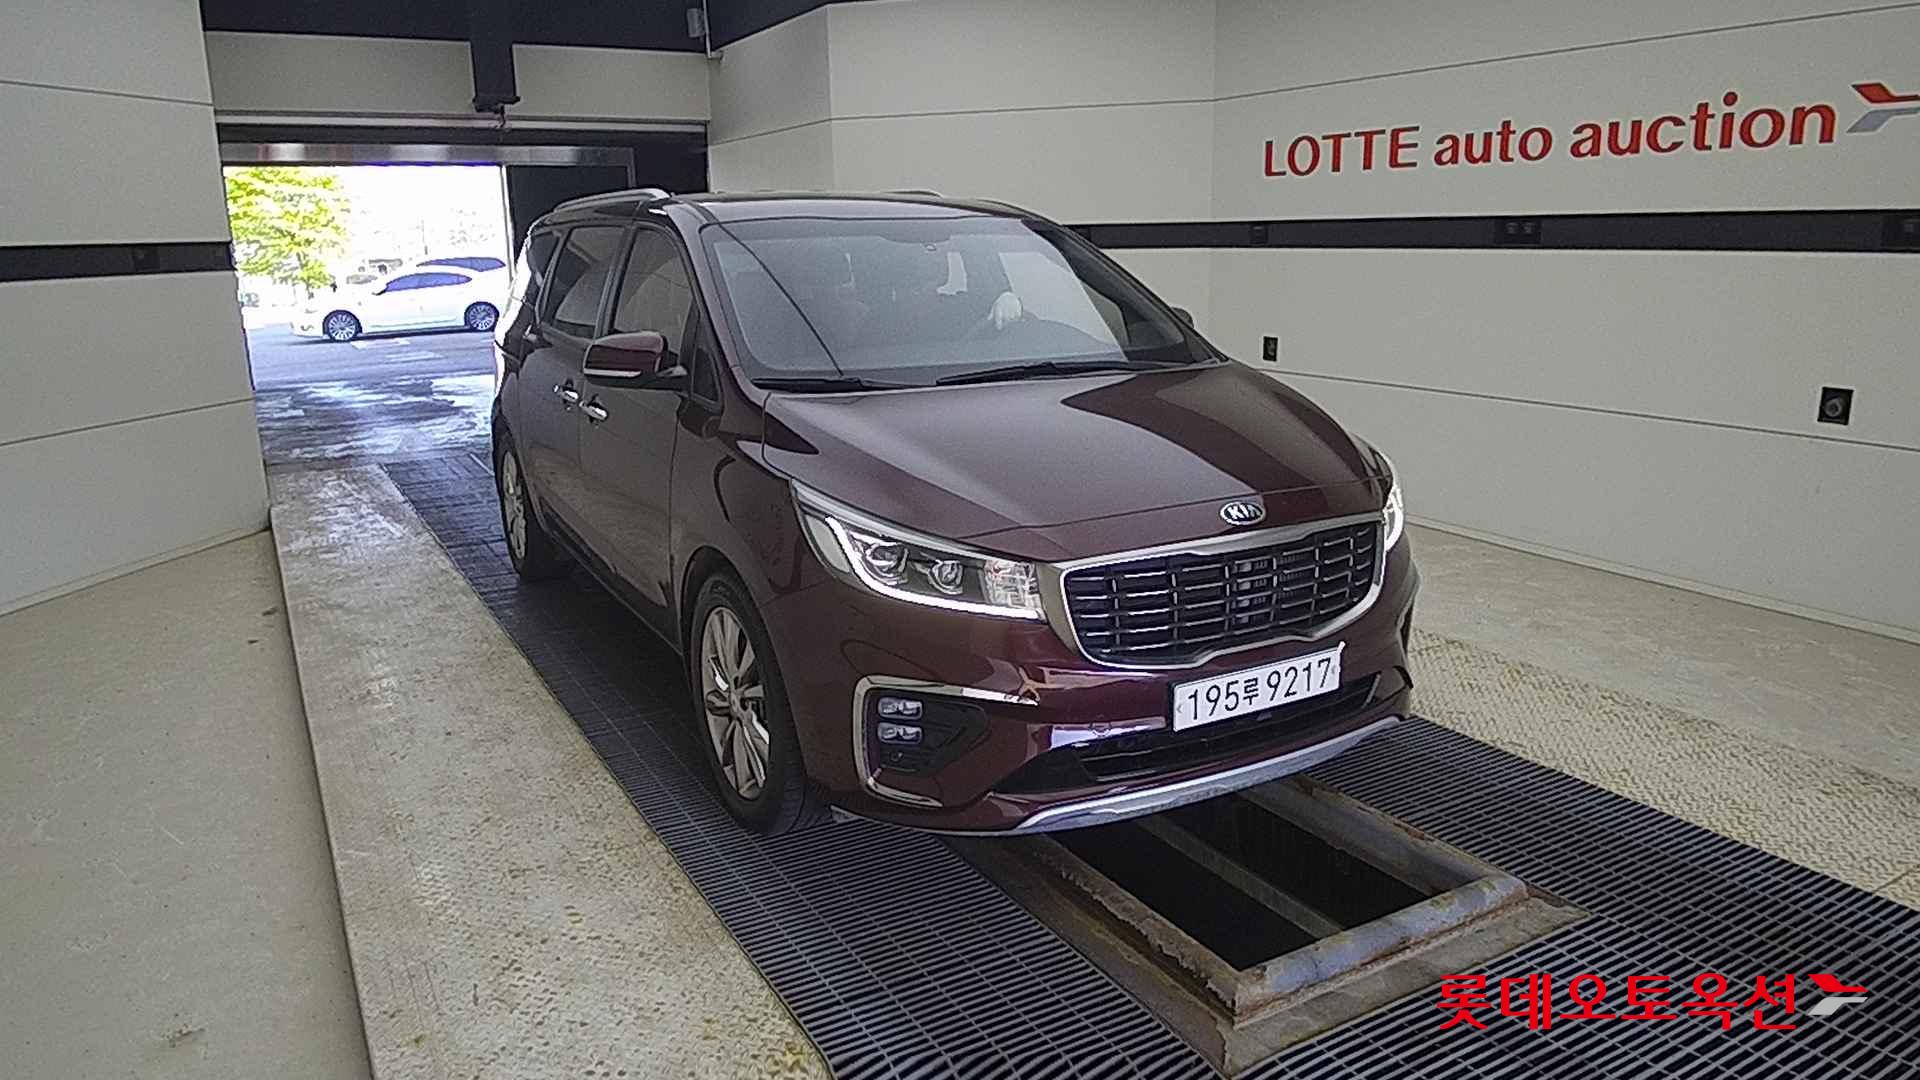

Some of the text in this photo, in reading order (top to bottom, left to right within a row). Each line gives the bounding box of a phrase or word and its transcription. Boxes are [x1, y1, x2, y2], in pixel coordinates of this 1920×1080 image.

[1264, 91, 1836, 177] LOTTE auto auction
[1226, 503, 1262, 520] KIA
[1266, 657, 1332, 702] 9217
